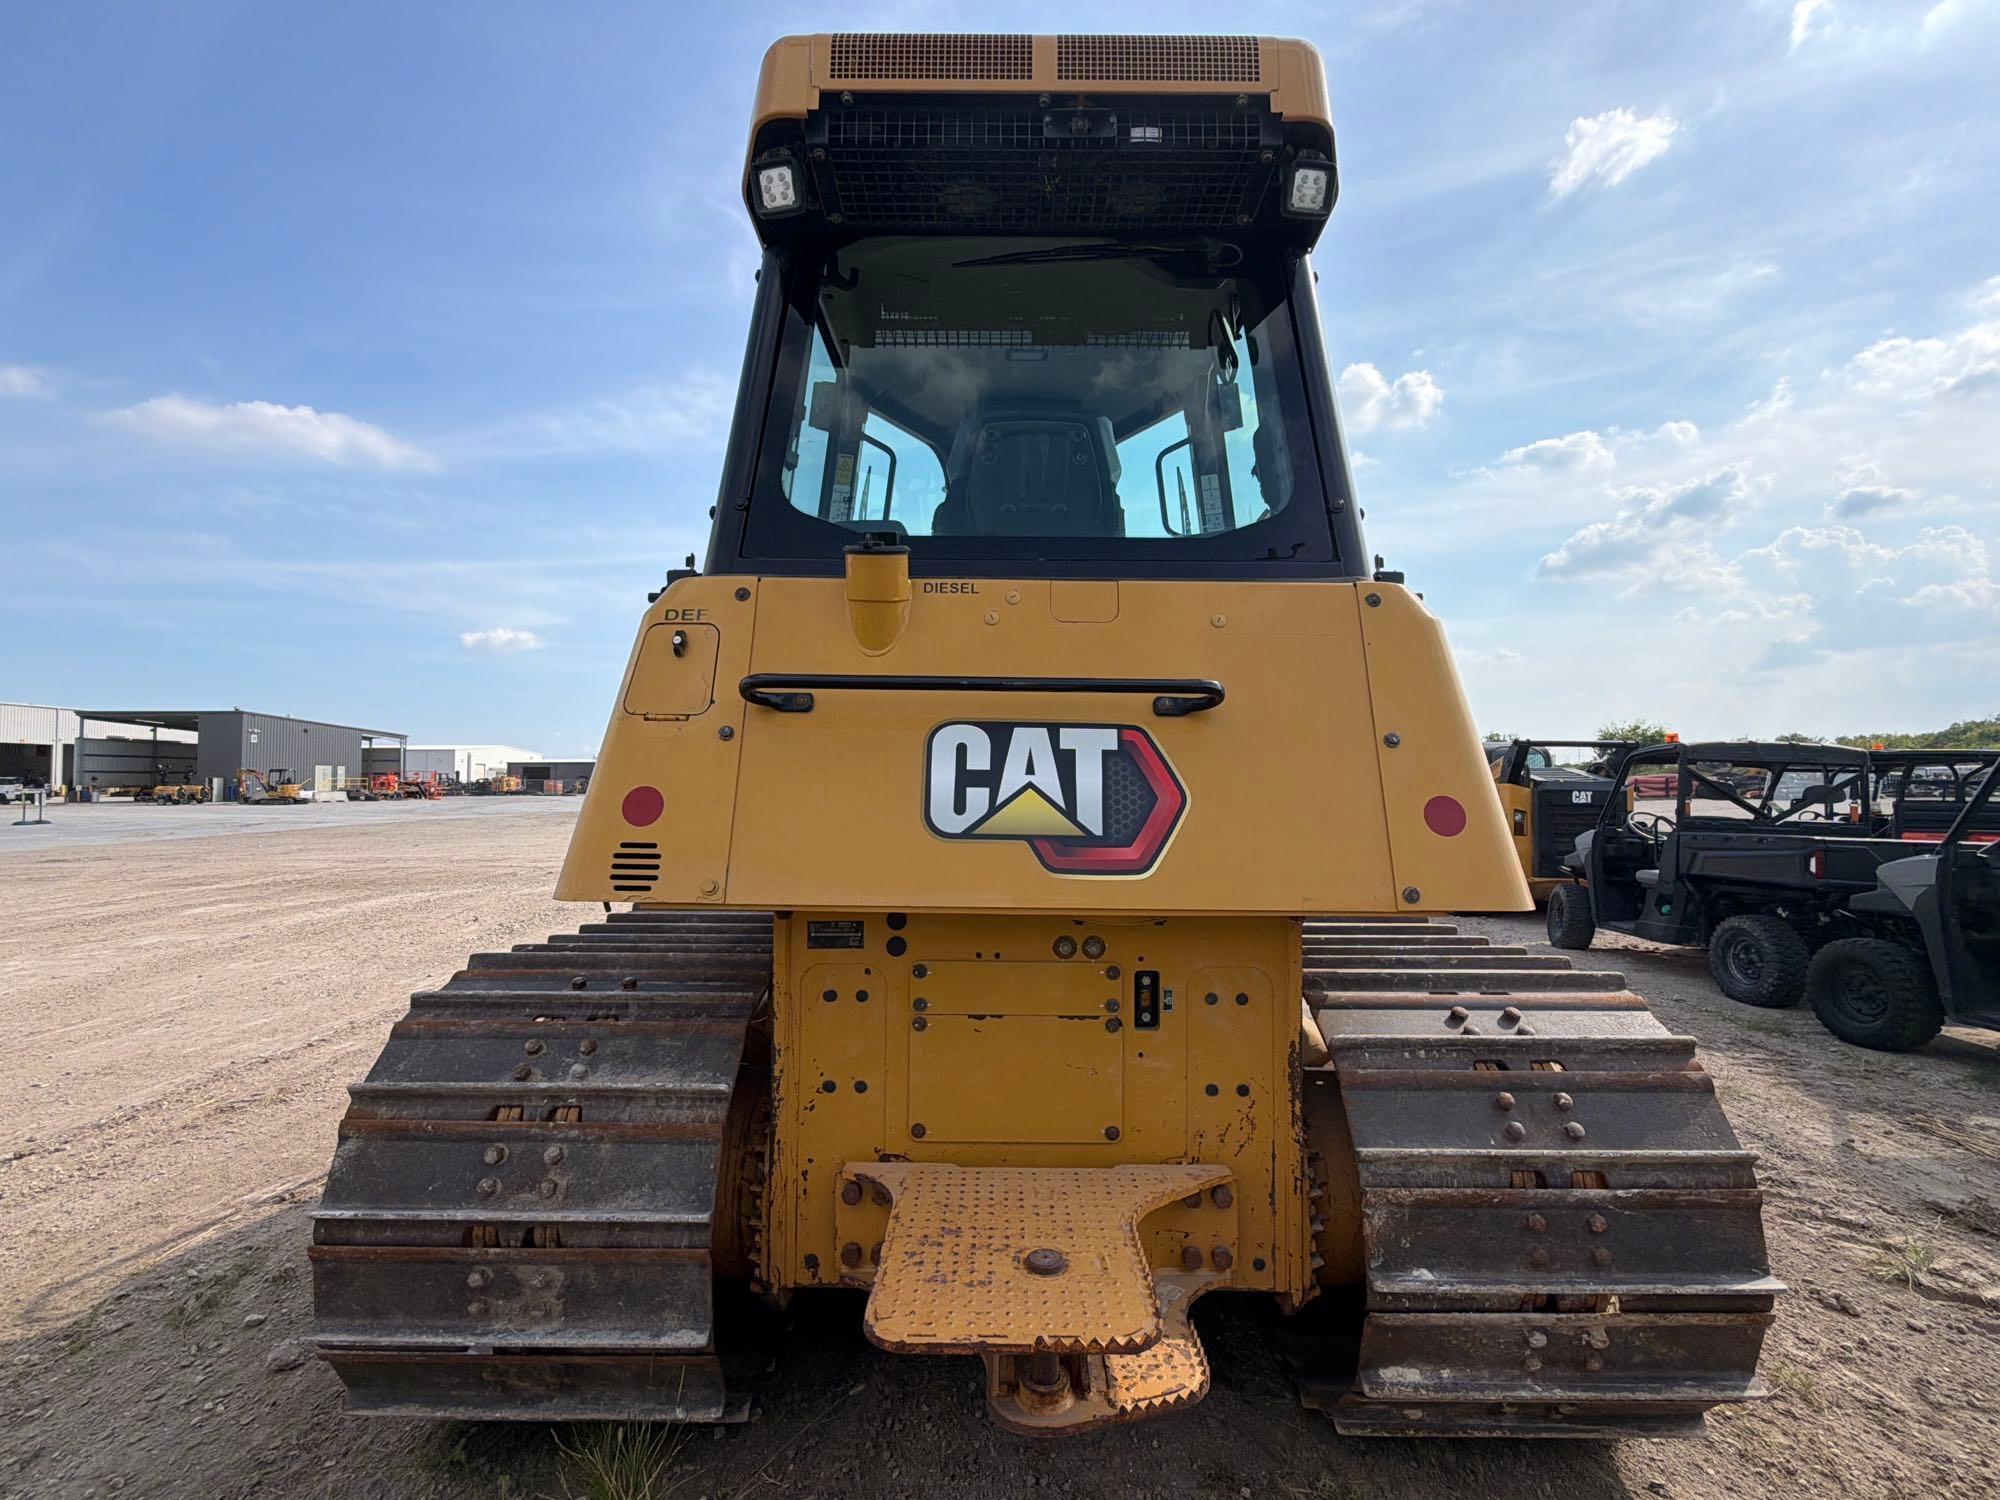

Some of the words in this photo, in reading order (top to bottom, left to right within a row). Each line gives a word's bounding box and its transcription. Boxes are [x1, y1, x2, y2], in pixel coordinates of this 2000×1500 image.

[923, 582, 980, 594] DIESEL
[664, 608, 709, 621] DEF
[929, 724, 1118, 836] CAT
[1572, 790, 1593, 804] CAT
